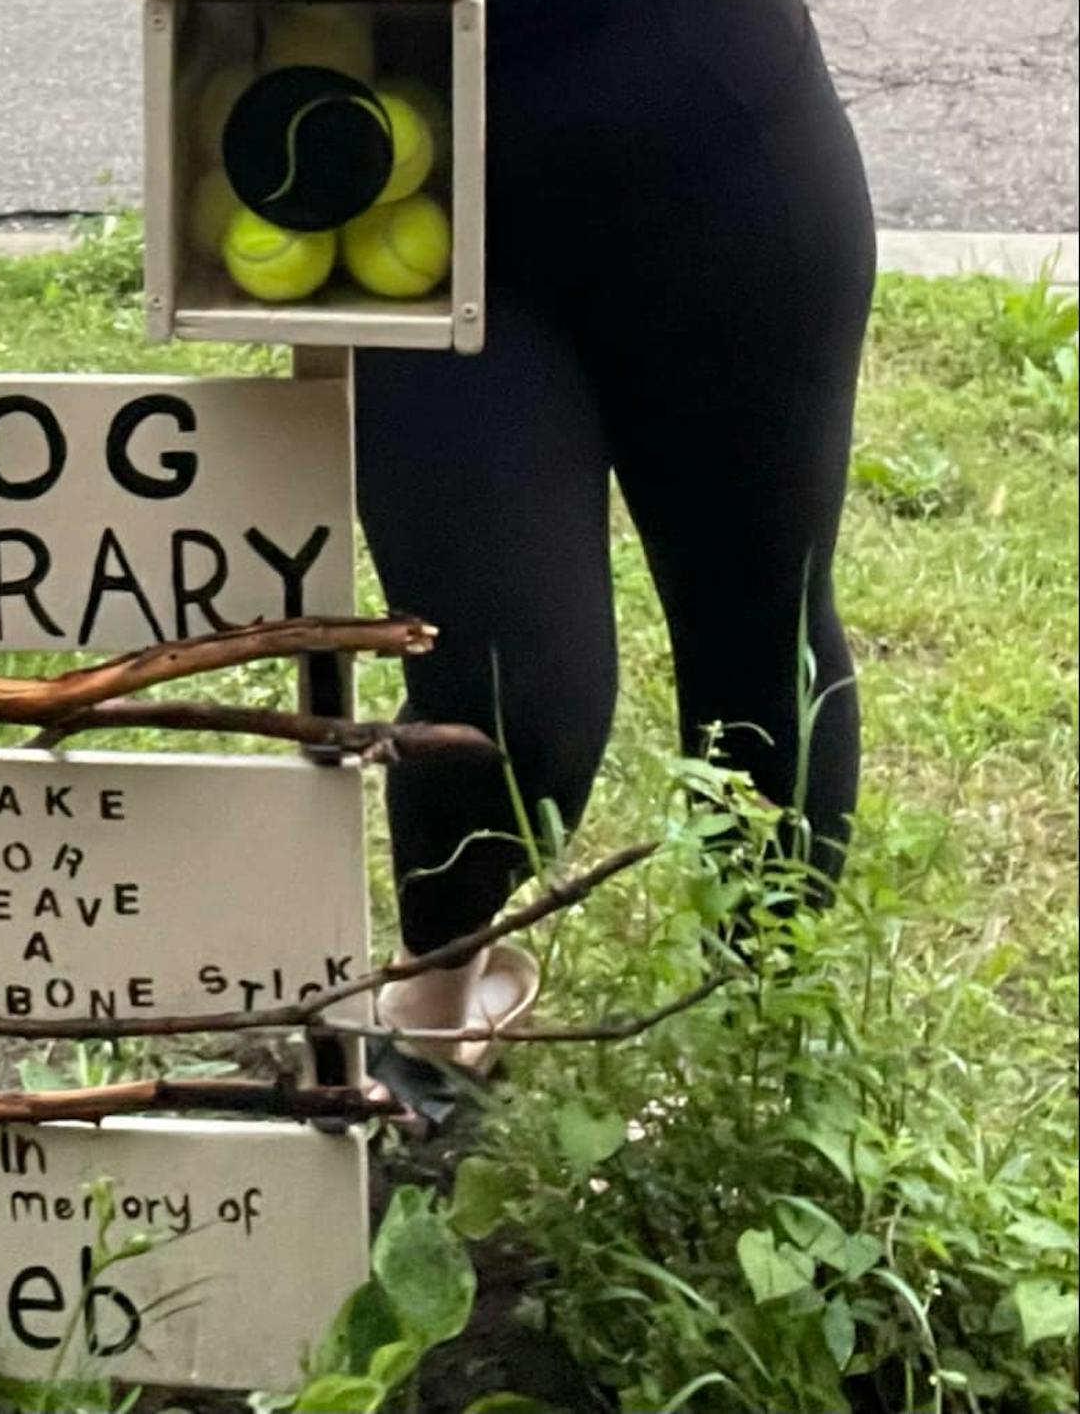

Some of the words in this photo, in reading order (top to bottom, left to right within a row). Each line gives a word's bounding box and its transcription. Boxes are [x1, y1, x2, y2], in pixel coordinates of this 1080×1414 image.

[2, 841, 84, 880] OR
[23, 931, 53, 963] A
[5, 977, 155, 1019] BONE
[0, 1127, 47, 1175] In
[218, 1187, 262, 1236] of
